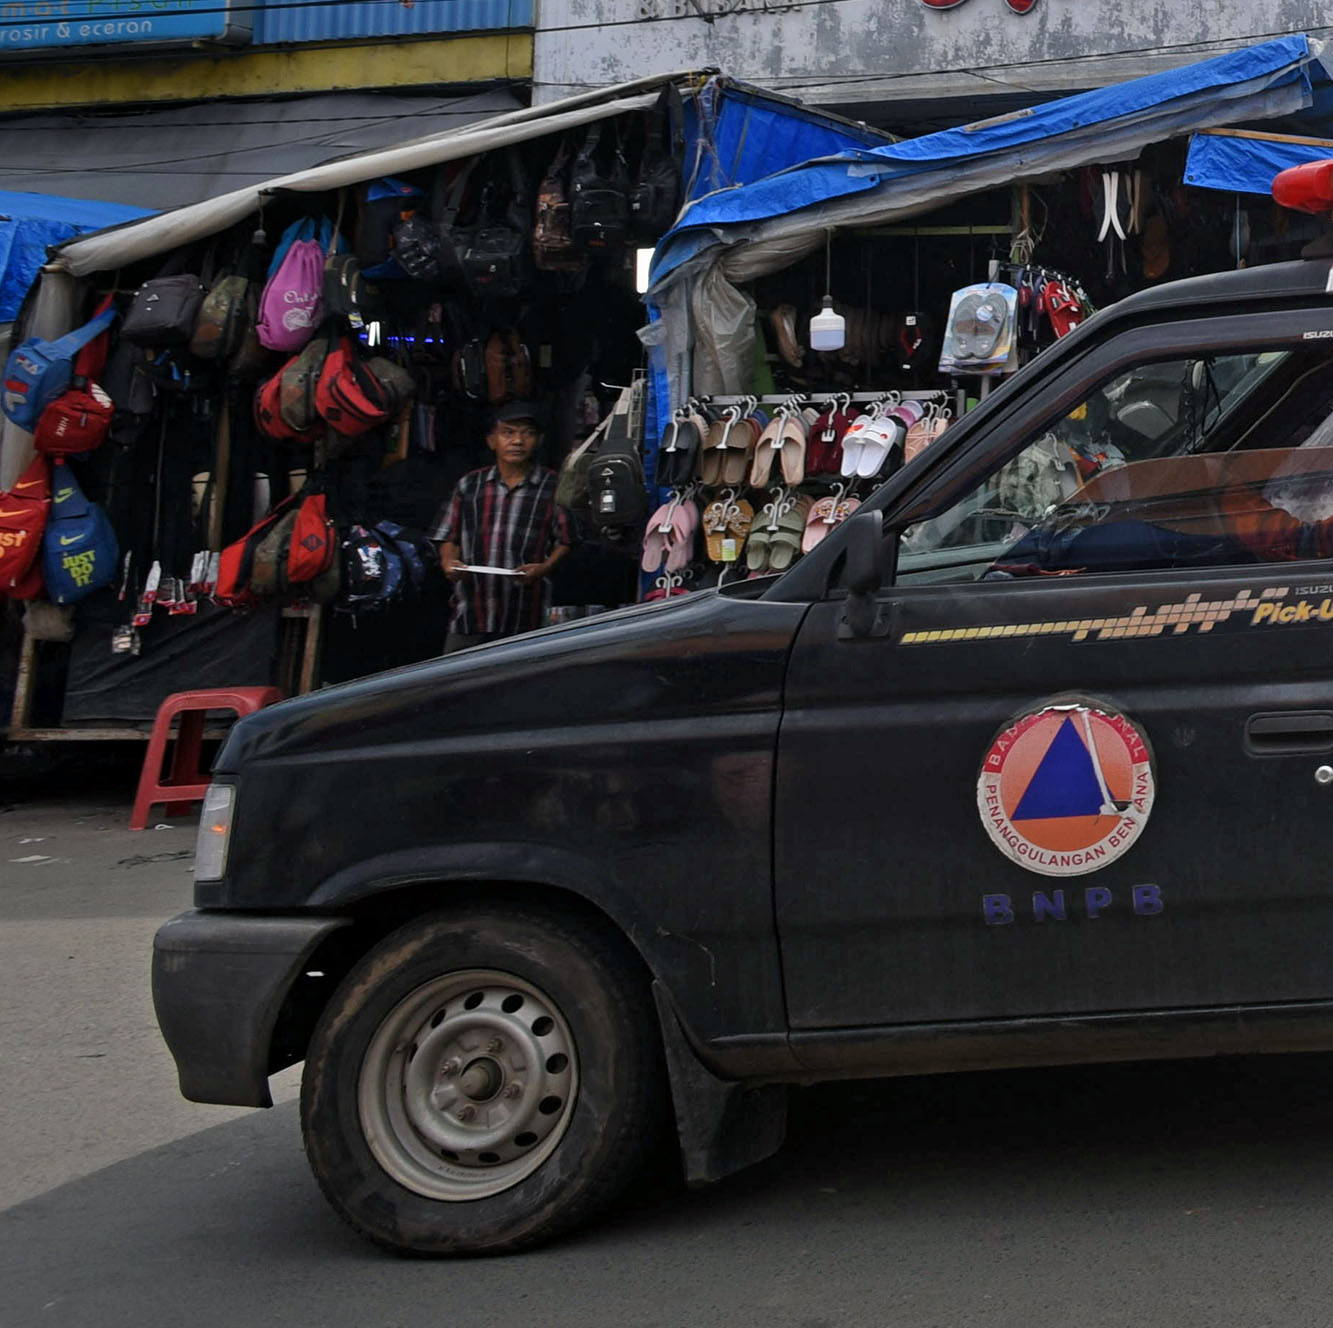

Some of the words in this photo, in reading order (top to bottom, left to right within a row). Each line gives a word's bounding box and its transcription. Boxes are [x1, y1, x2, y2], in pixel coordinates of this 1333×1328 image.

[56, 22, 71, 38] &
[80, 20, 153, 37] eceran
[985, 784, 1106, 867] PENANGGULANGAN
[1108, 771, 1149, 849] BENANA
